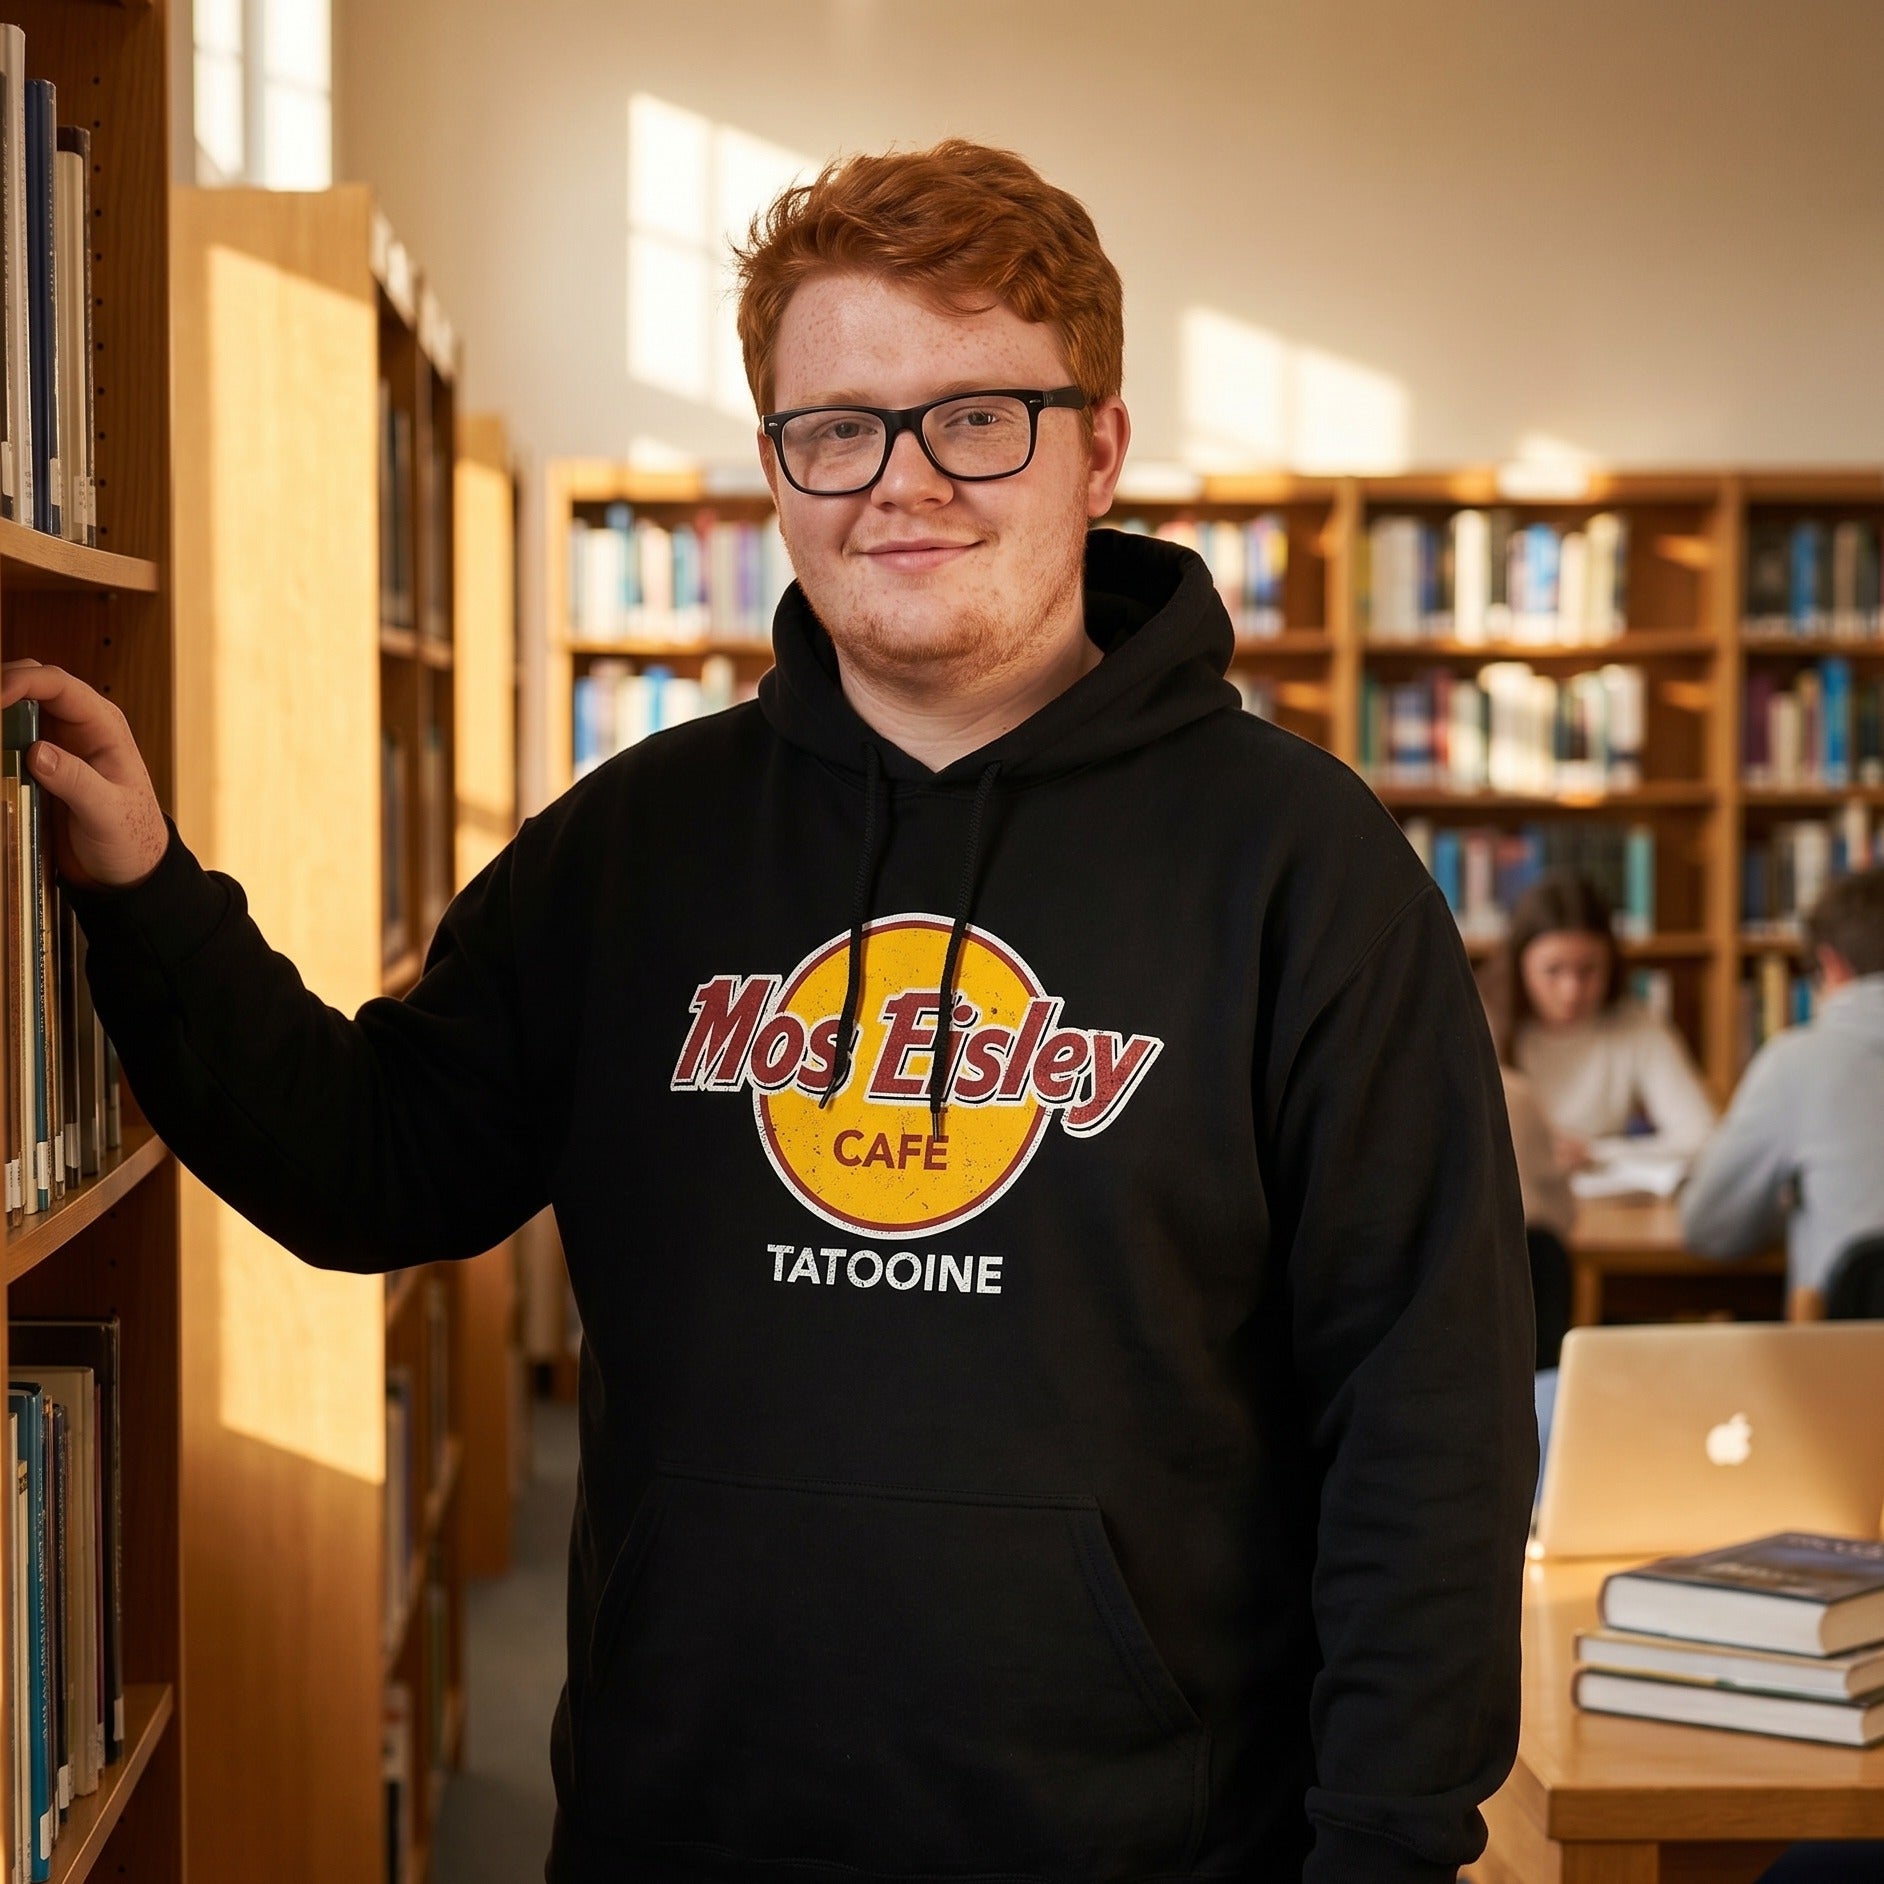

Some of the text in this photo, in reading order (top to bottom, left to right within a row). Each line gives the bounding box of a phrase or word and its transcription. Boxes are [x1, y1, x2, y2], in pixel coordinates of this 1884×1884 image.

[671, 975, 1162, 1136] Mos Eisley
[833, 1129, 949, 1171] CAFE
[766, 1243, 1004, 1294] TATOOINE
